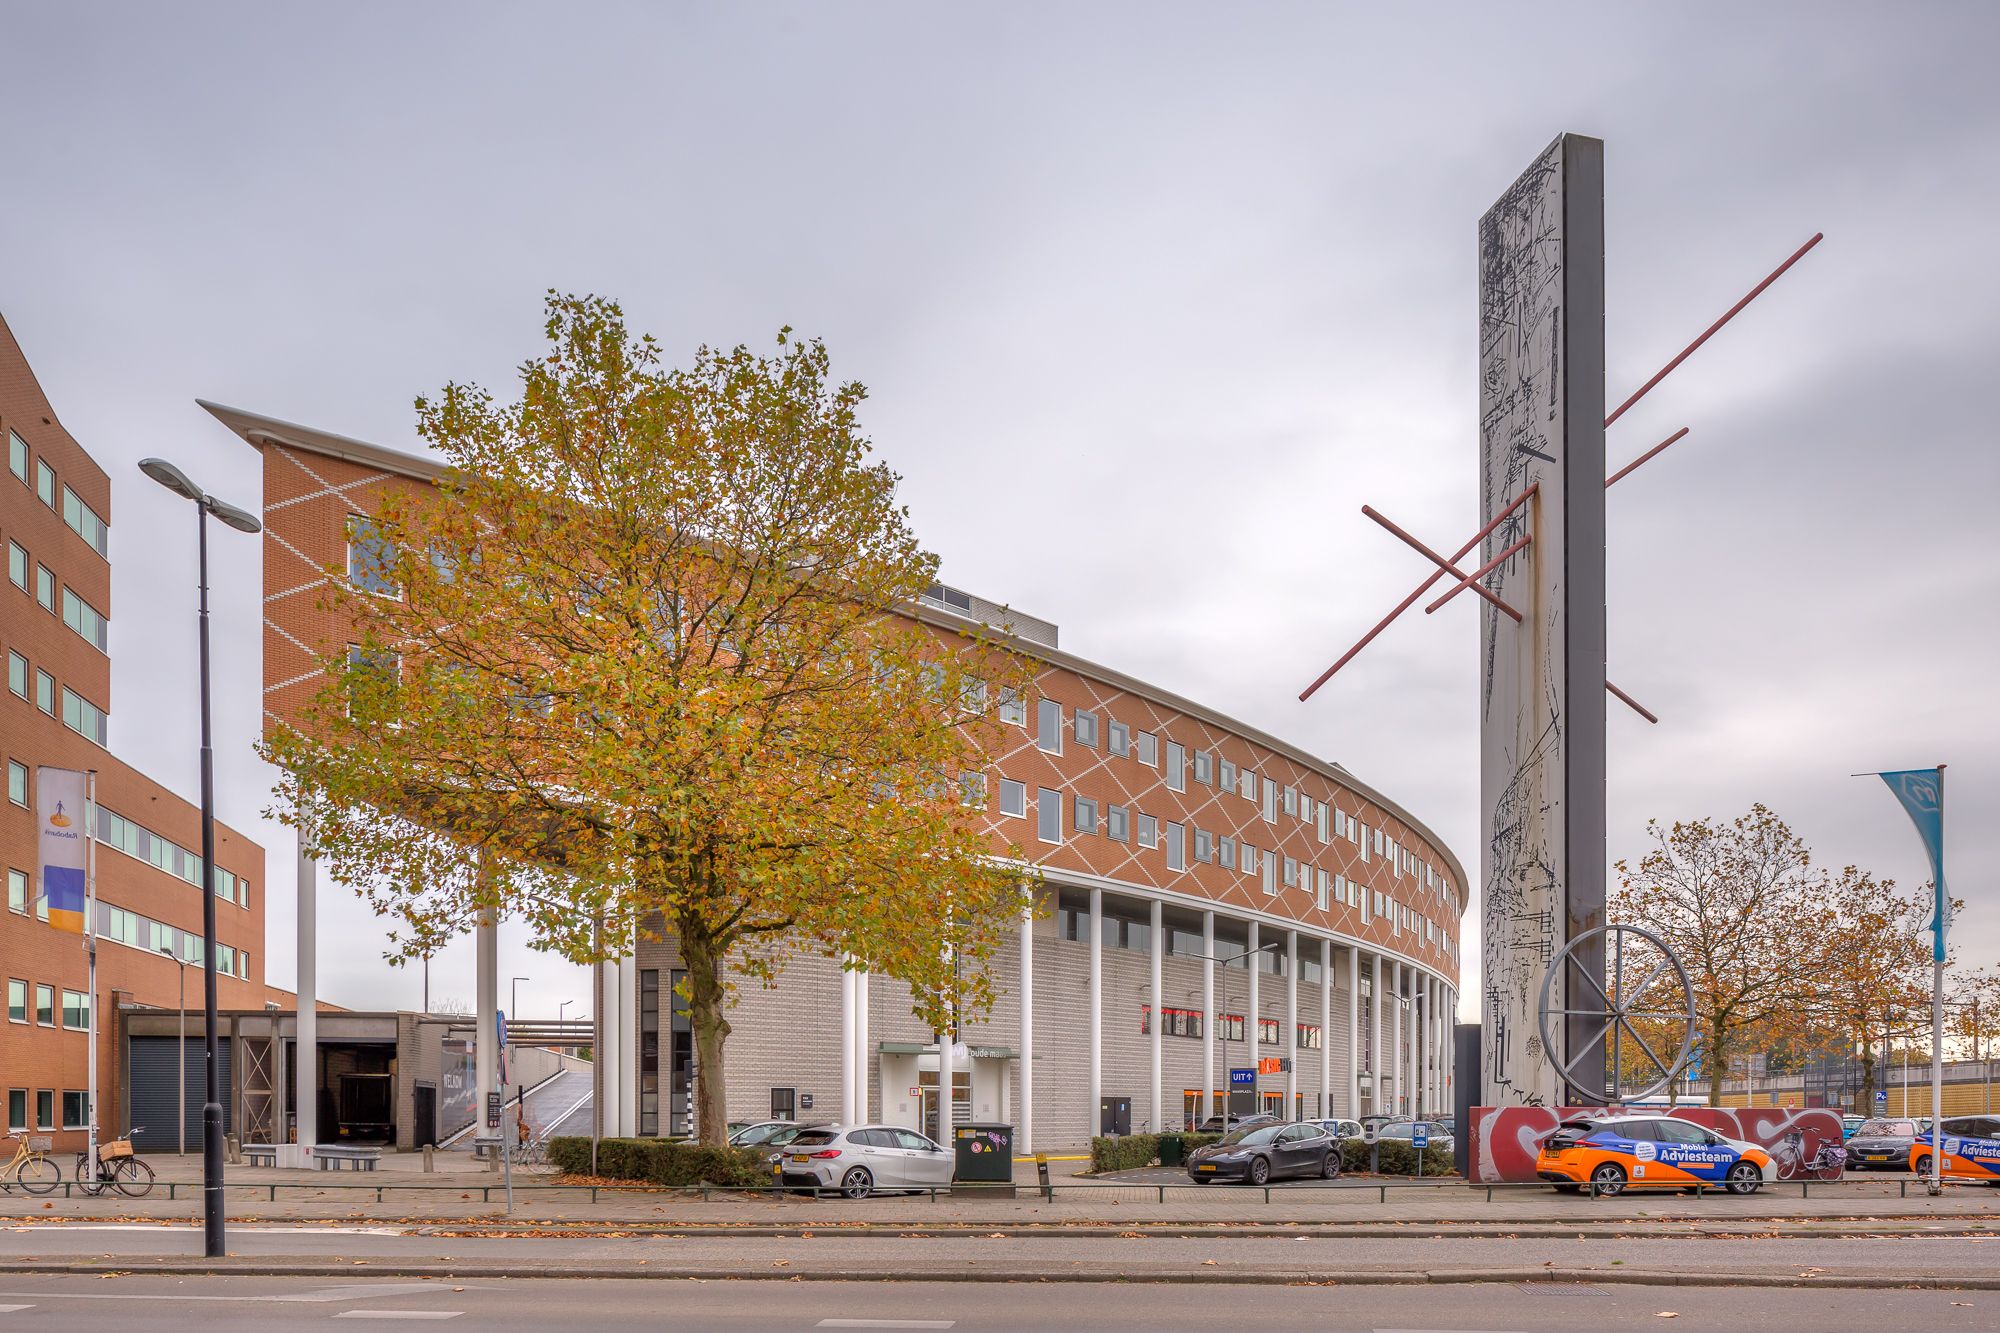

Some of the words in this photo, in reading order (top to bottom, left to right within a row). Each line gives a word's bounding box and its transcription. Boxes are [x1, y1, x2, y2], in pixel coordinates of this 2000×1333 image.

[970, 1048, 988, 1058] oude
[1232, 1073, 1246, 1081] UIT
[1876, 1092, 1882, 1100] P
[1680, 1143, 1708, 1151] Mobiel
[1961, 1144, 2000, 1158] Advieste
[1660, 1149, 1733, 1162] Adviesteam
